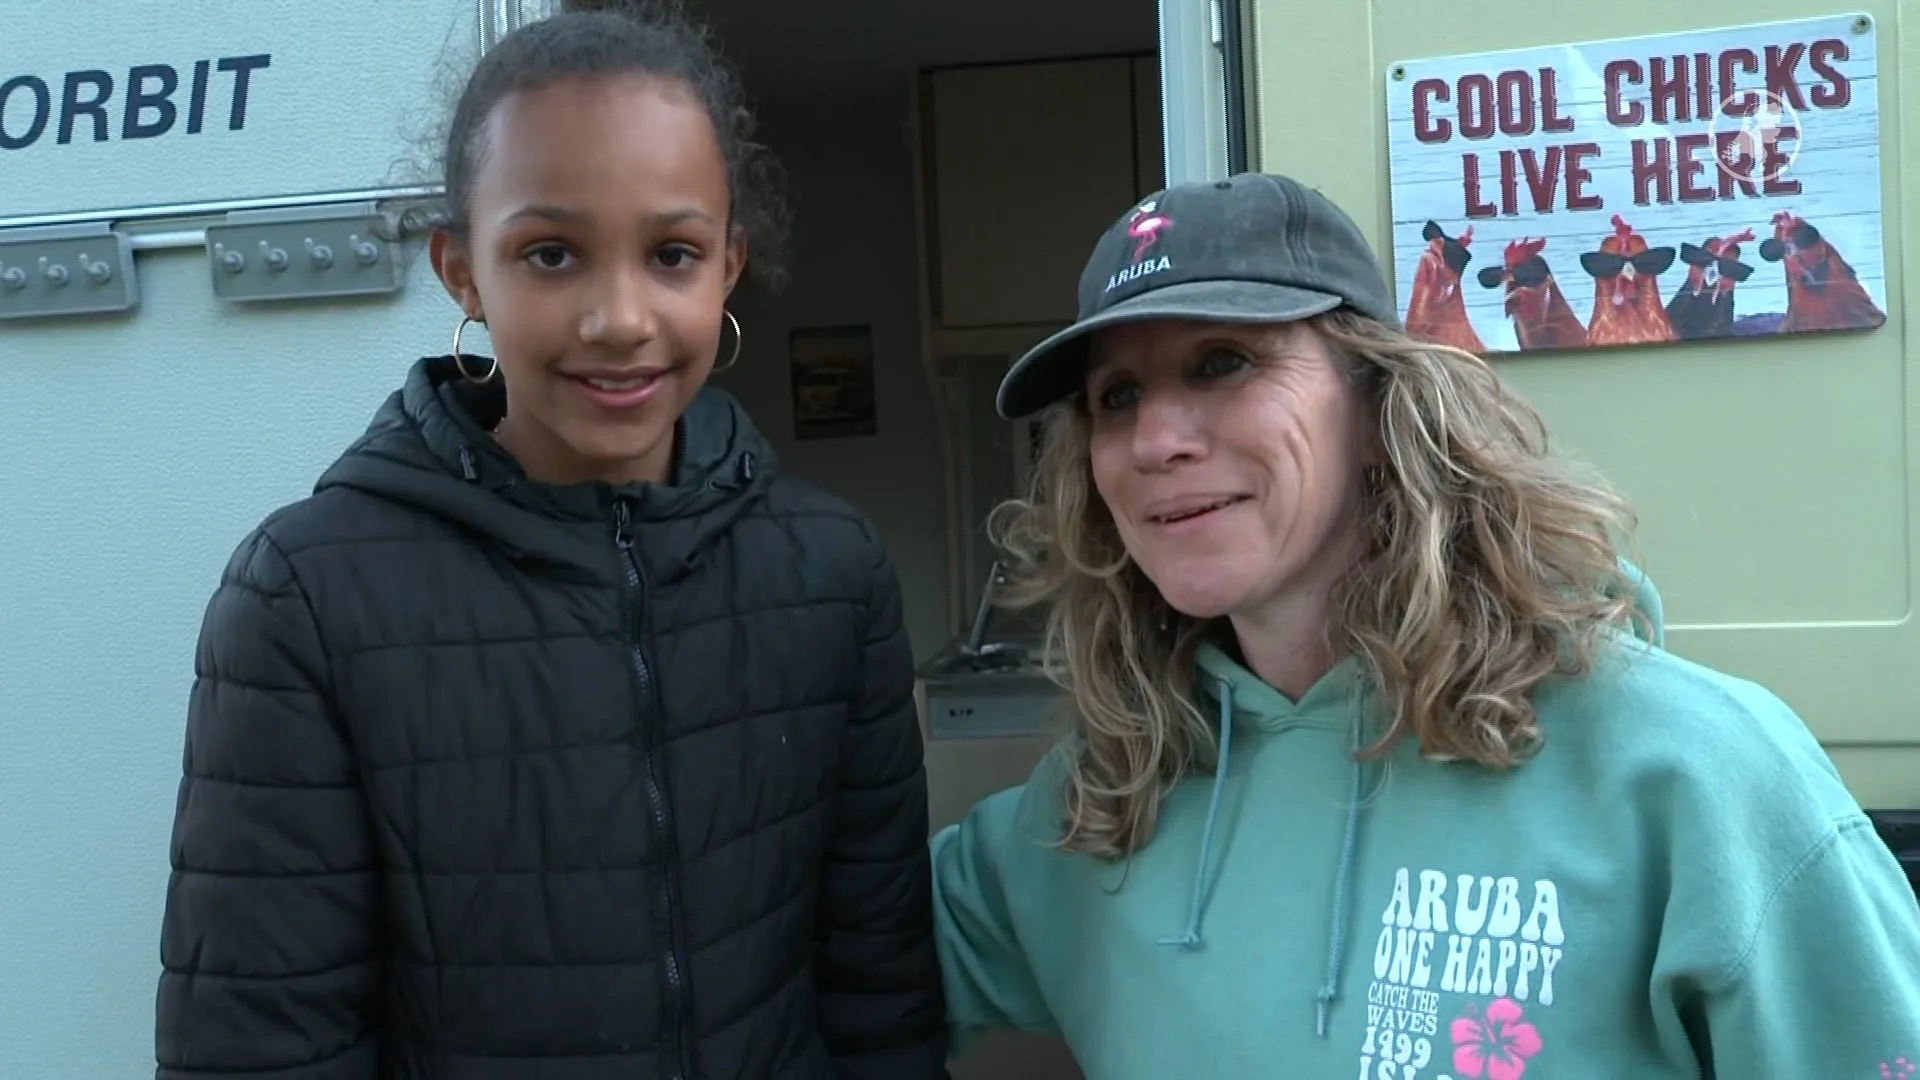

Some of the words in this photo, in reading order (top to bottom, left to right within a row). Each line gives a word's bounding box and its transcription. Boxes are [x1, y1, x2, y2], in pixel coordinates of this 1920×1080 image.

[0, 54, 271, 150] ORBIT
[1411, 66, 1575, 144] COOL
[1603, 38, 1851, 128] CHICKS
[1462, 142, 1603, 218] LIVE
[1631, 126, 1802, 206] HERE
[1104, 255, 1171, 294] ARUBA
[1381, 867, 1565, 945] ARUBA
[1367, 981, 1410, 1008] CATCH
[1411, 989, 1439, 1015] THE
[1374, 926, 1435, 988] ONE
[1440, 935, 1562, 1006] HAPPY
[1367, 1004, 1437, 1036] WAVES
